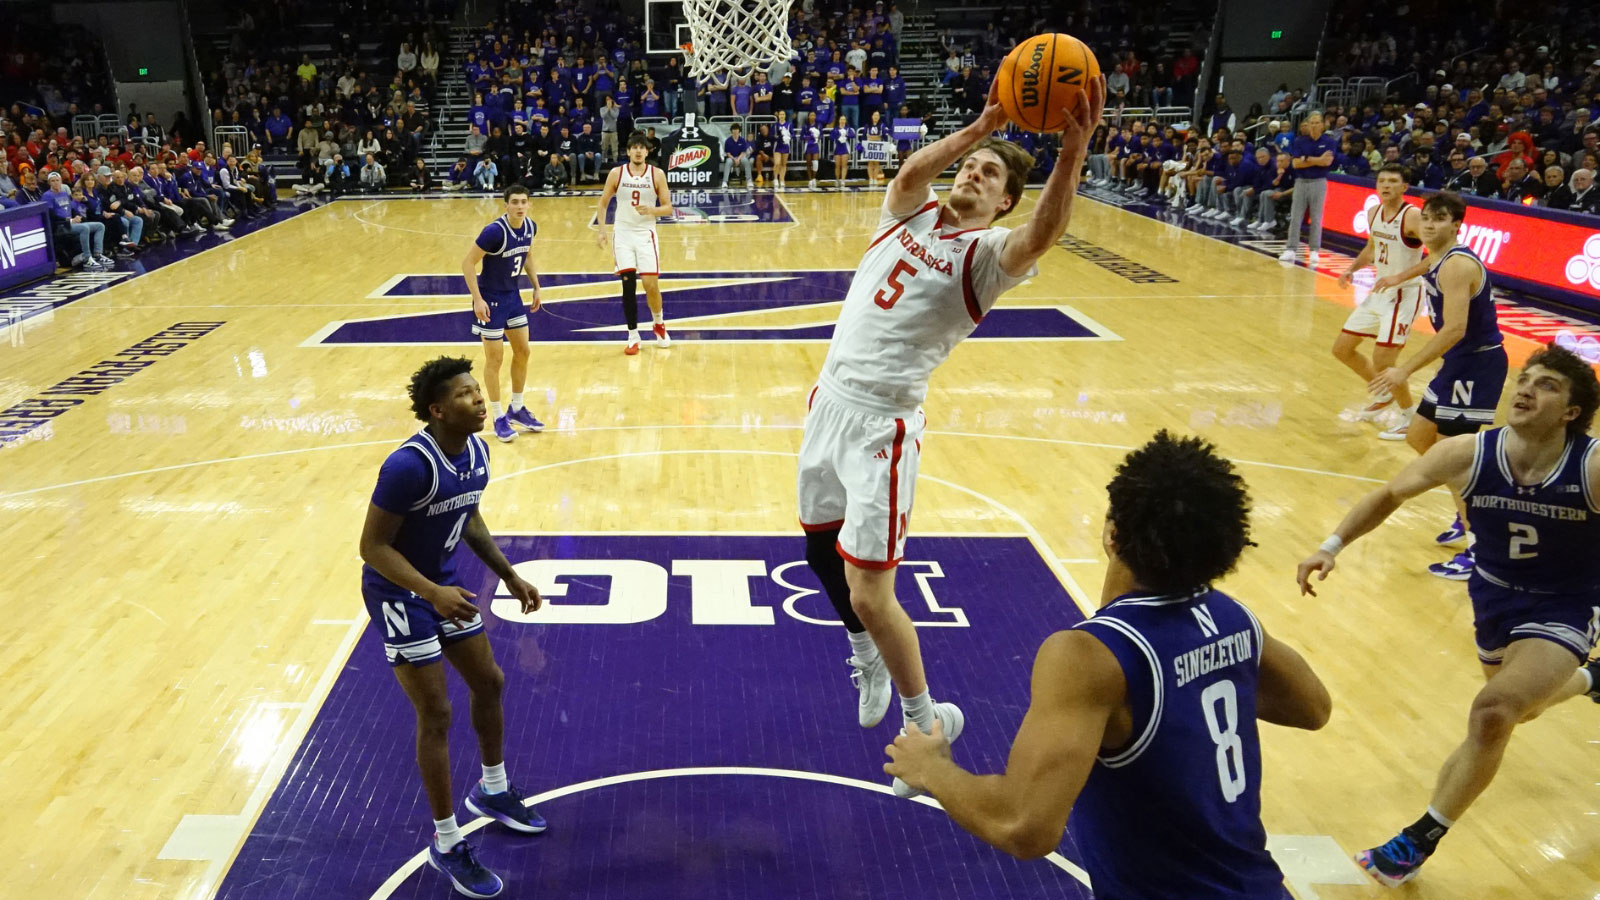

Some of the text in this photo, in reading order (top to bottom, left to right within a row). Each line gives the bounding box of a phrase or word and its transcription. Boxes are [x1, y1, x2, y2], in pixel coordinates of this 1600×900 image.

[1022, 41, 1047, 108] Wilson
[1057, 65, 1083, 85] N
[668, 148, 708, 170] LIBMAN
[862, 151, 888, 161] LOUD!
[867, 142, 884, 152] GET
[667, 167, 713, 186] meijer
[631, 190, 641, 207] 9
[510, 255, 523, 278] 3
[1378, 241, 1389, 266] 21
[873, 257, 919, 311] 5
[38, 320, 228, 396] WELSH-RYAN
[1451, 380, 1475, 406] N
[1471, 495, 1587, 521] NORTHWESTERN
[444, 511, 468, 552] 4
[1508, 522, 1540, 560] 2
[382, 601, 412, 638] N
[1190, 603, 1220, 638] N
[1173, 629, 1252, 688] SINGLETON
[1201, 679, 1247, 804] 8
